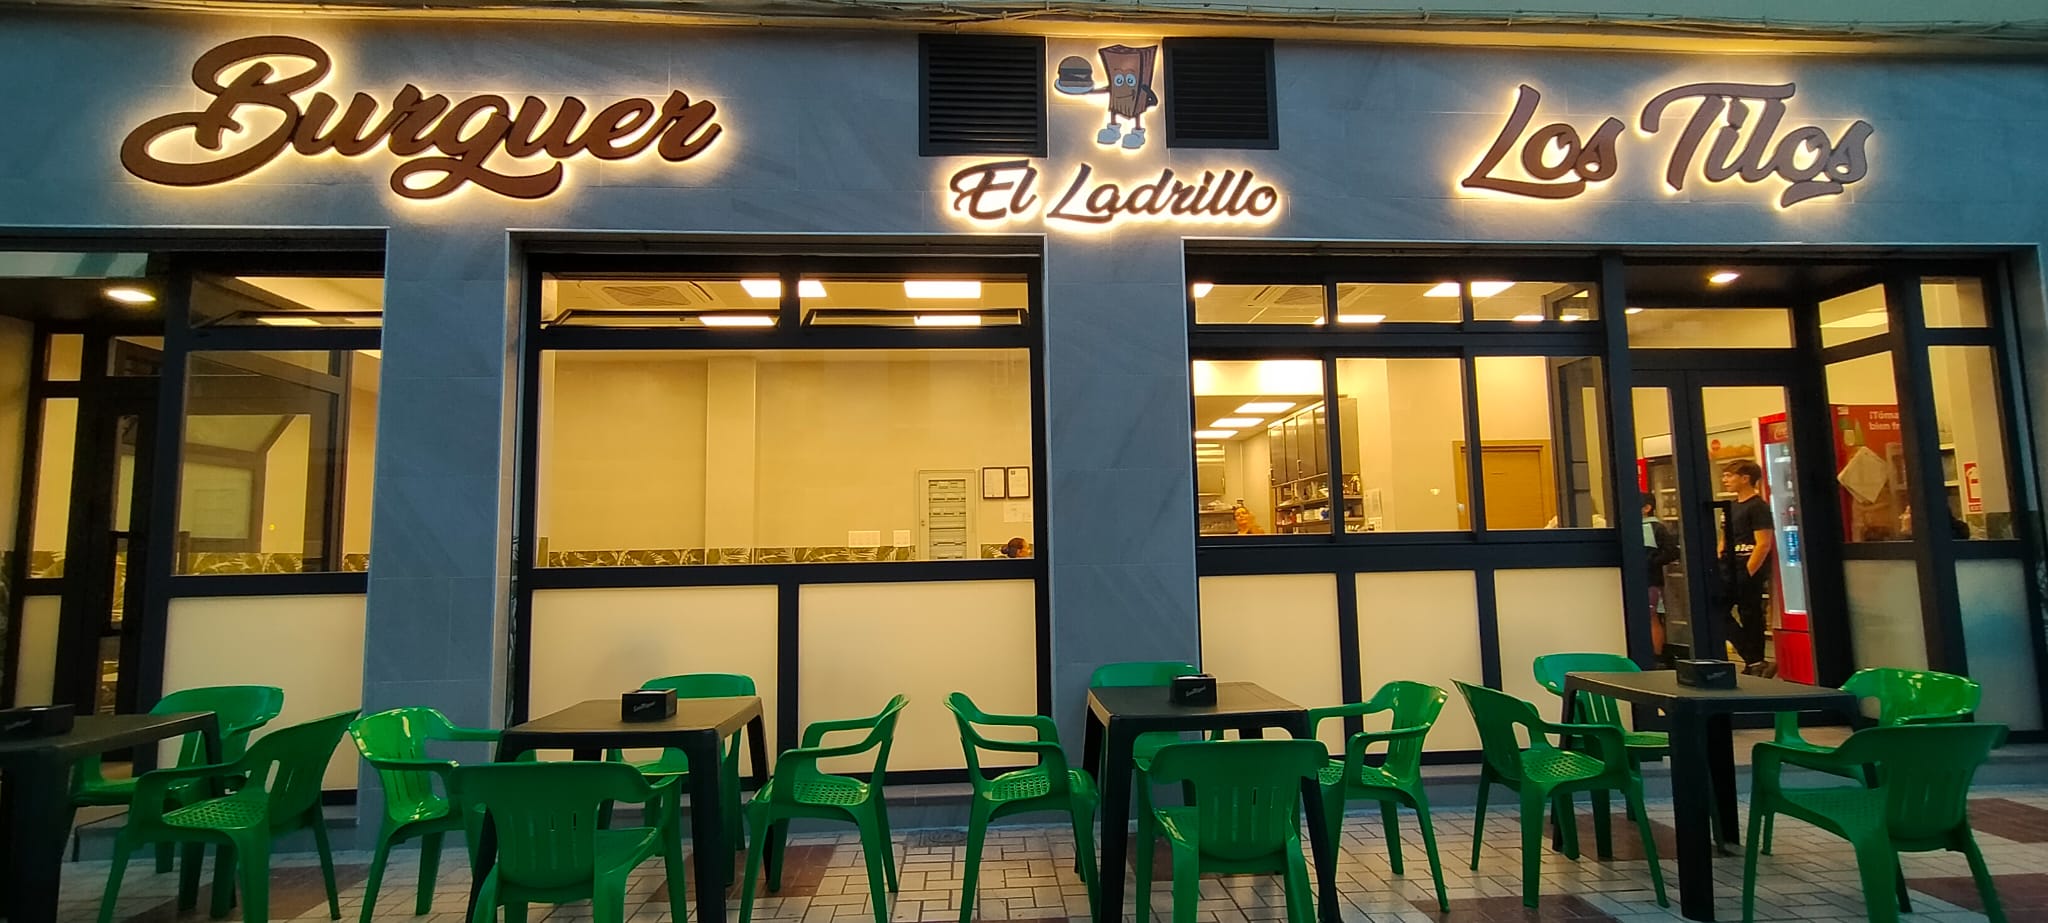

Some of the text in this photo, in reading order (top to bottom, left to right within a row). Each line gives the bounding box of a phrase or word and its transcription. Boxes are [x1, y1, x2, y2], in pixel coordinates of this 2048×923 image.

[121, 36, 721, 199] Burguer
[1462, 82, 1874, 208] Los Tilos
[950, 160, 1278, 223] El Ladrillo
